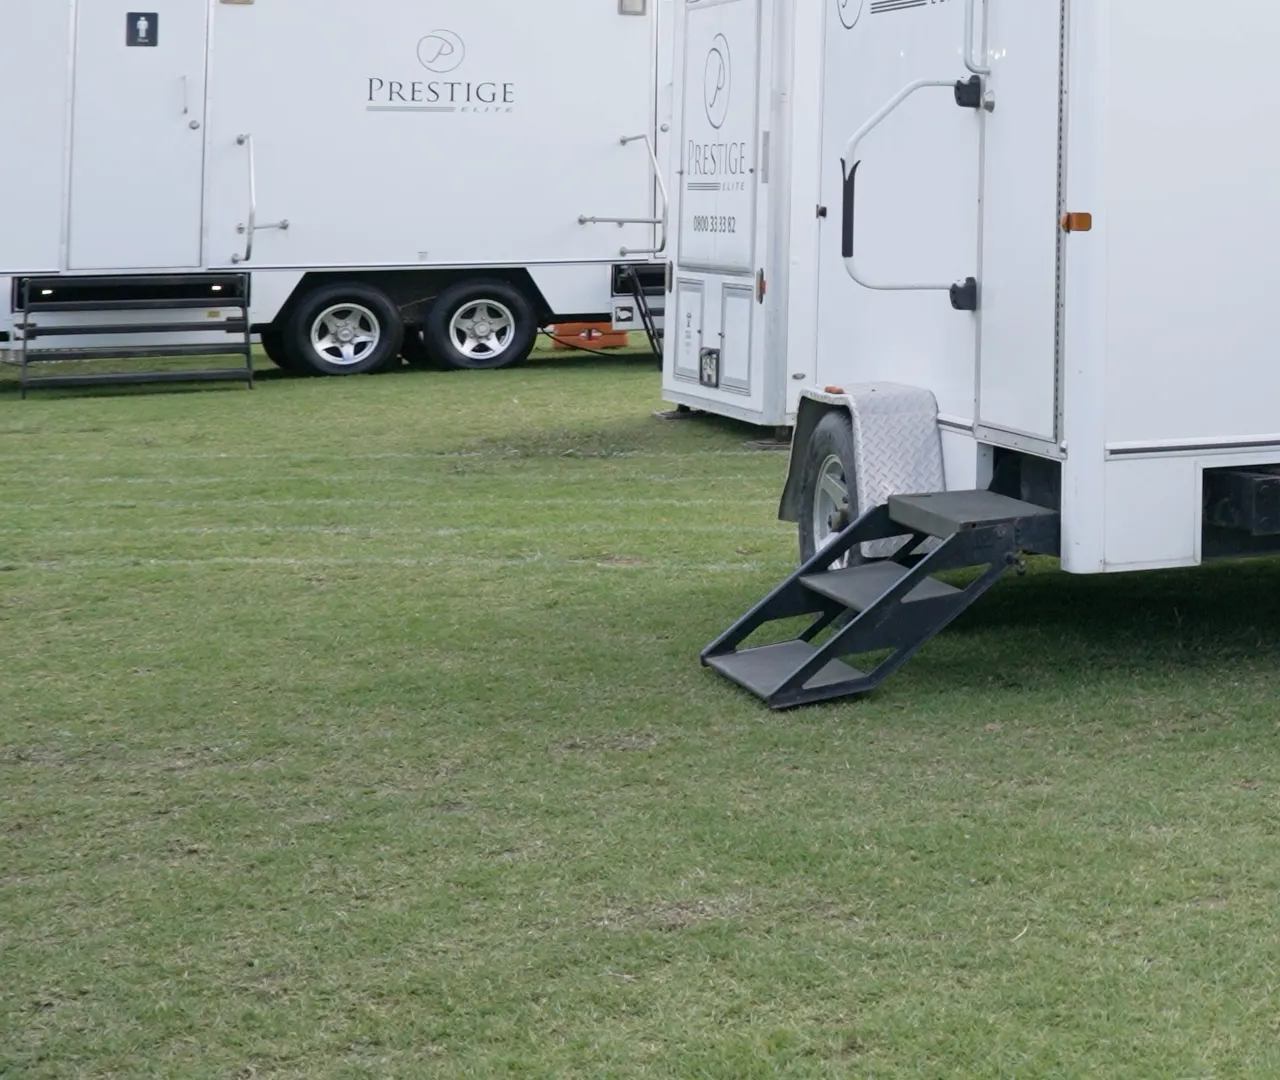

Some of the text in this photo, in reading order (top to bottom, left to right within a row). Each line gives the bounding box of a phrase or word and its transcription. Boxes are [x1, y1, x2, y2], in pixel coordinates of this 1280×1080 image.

[367, 77, 515, 104] PRESTIGE
[687, 139, 746, 175] PRESTIGE
[722, 181, 745, 191] ELITE
[693, 216, 736, 234] 0800 33 33 82
